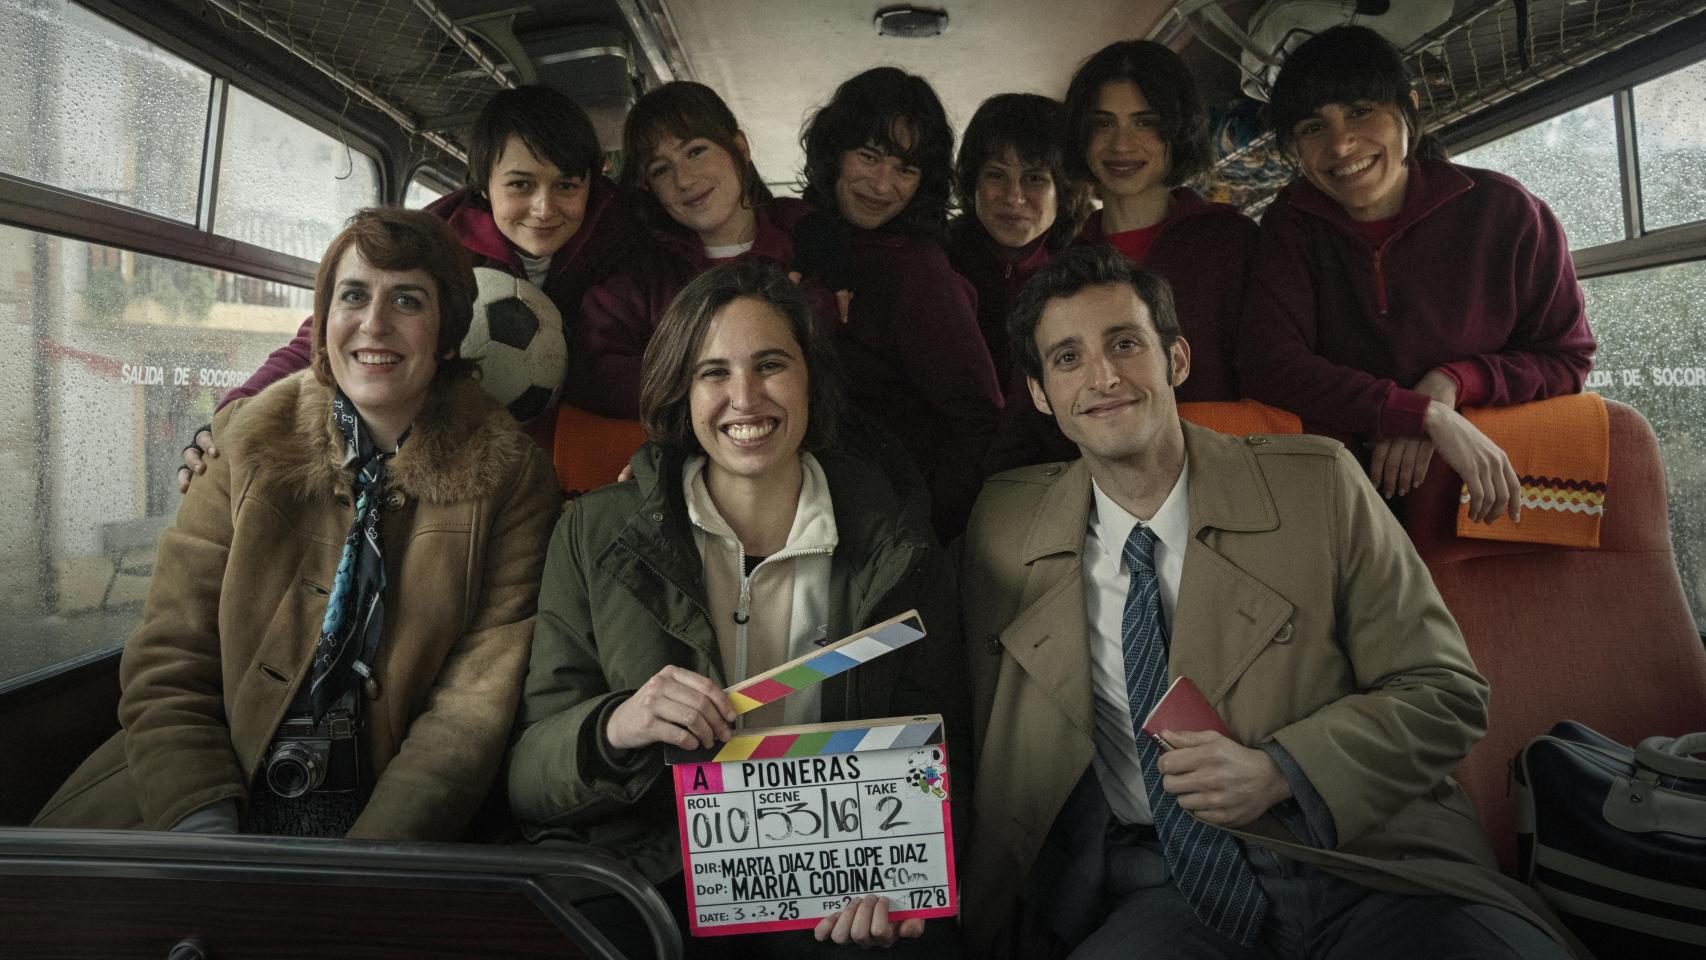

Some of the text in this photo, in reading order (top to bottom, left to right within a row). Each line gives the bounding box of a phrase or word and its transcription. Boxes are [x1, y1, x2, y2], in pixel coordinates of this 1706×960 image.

[121, 363, 164, 386] SALIDA
[174, 366, 191, 386] DE
[1622, 368, 1641, 386] DE
[1652, 367, 1706, 386] SOCOR
[693, 765, 709, 790] A
[742, 754, 861, 788] PIONERAS
[758, 790, 801, 804] SCENE
[864, 782, 898, 796] TAKE
[687, 797, 721, 810] ROLL
[875, 796, 912, 831] 2
[692, 807, 750, 849] 010
[694, 843, 928, 878] DIR: MARTA DIAZ DE LOPE DIAZ
[696, 866, 885, 901] DoP: MARIA CODINA
[822, 900, 841, 910] FPS
[699, 912, 729, 923] DATE:
